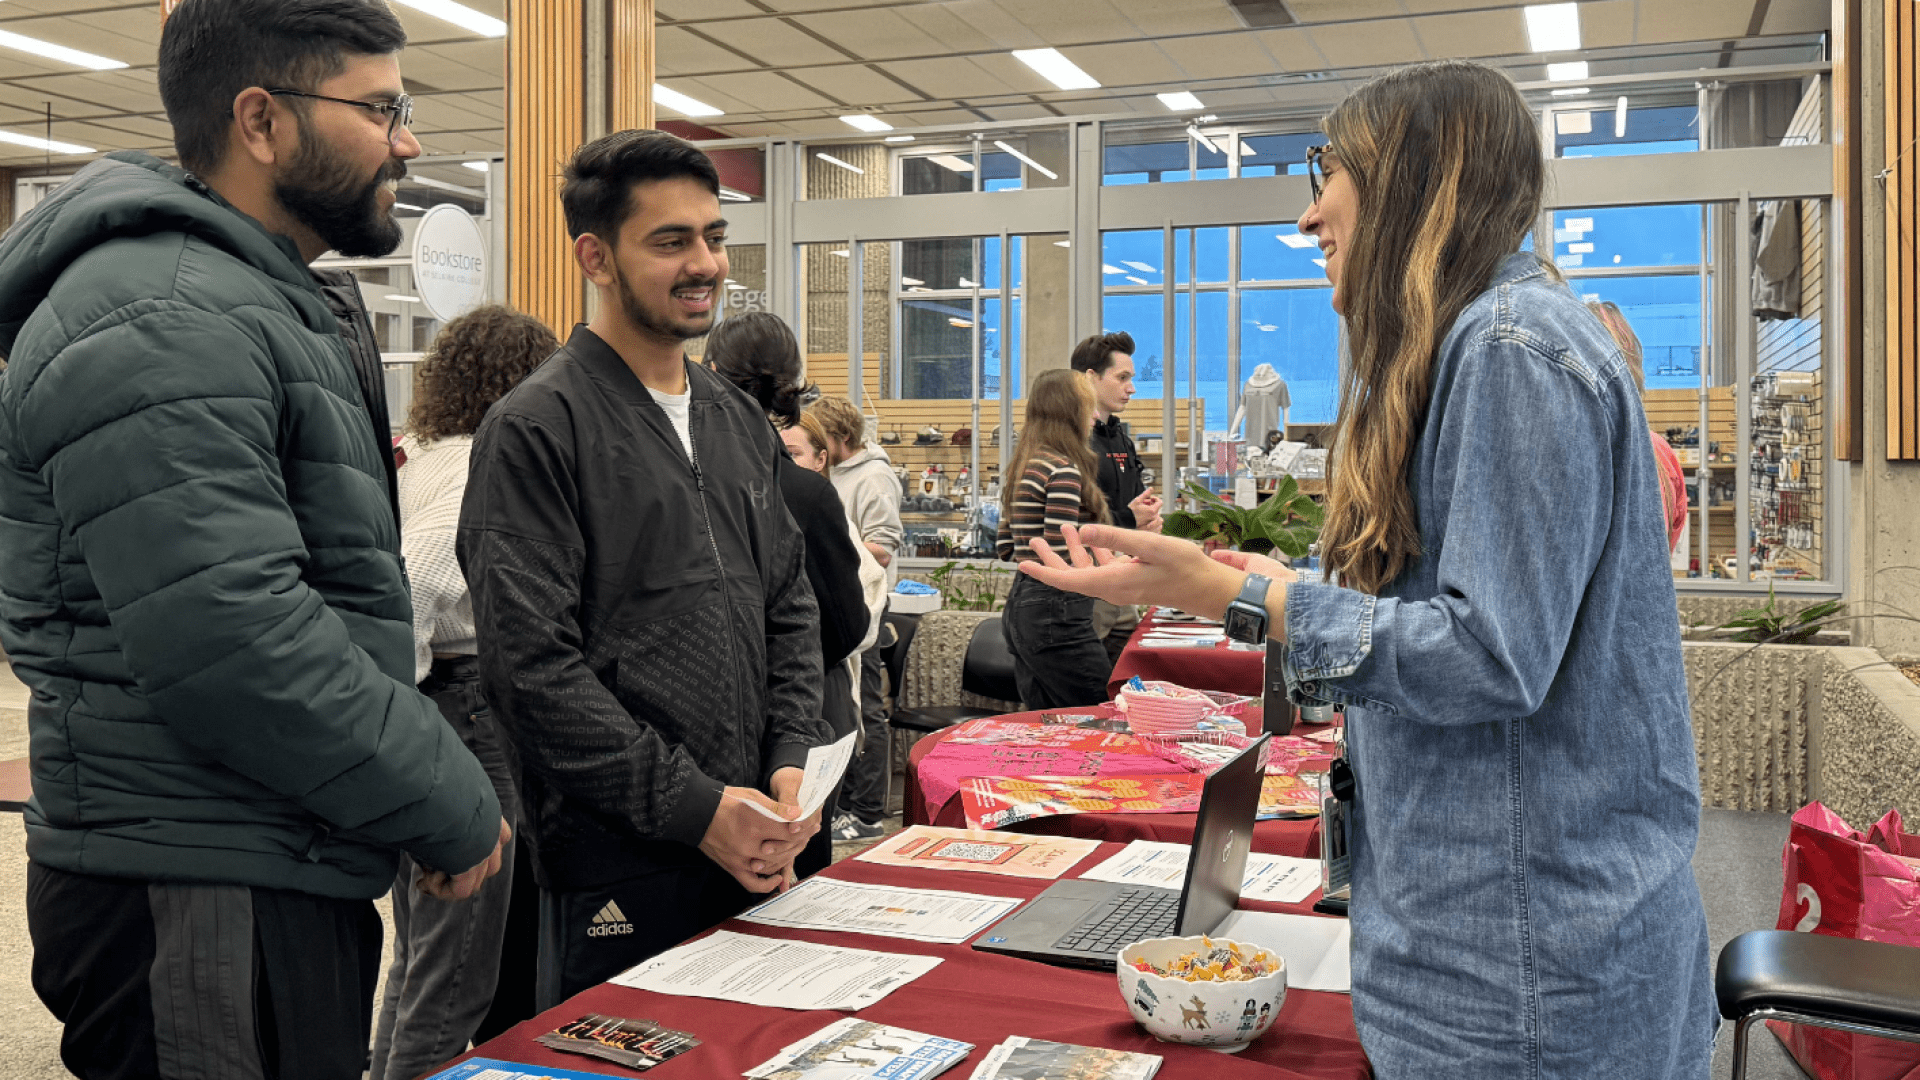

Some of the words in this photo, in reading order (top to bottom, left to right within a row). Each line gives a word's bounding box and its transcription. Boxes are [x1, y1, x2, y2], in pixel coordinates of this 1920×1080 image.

[422, 245, 481, 272] Bookstore
[649, 653, 699, 687] ARMOUR
[630, 670, 672, 699] UNDER
[586, 922, 634, 938] adidas
